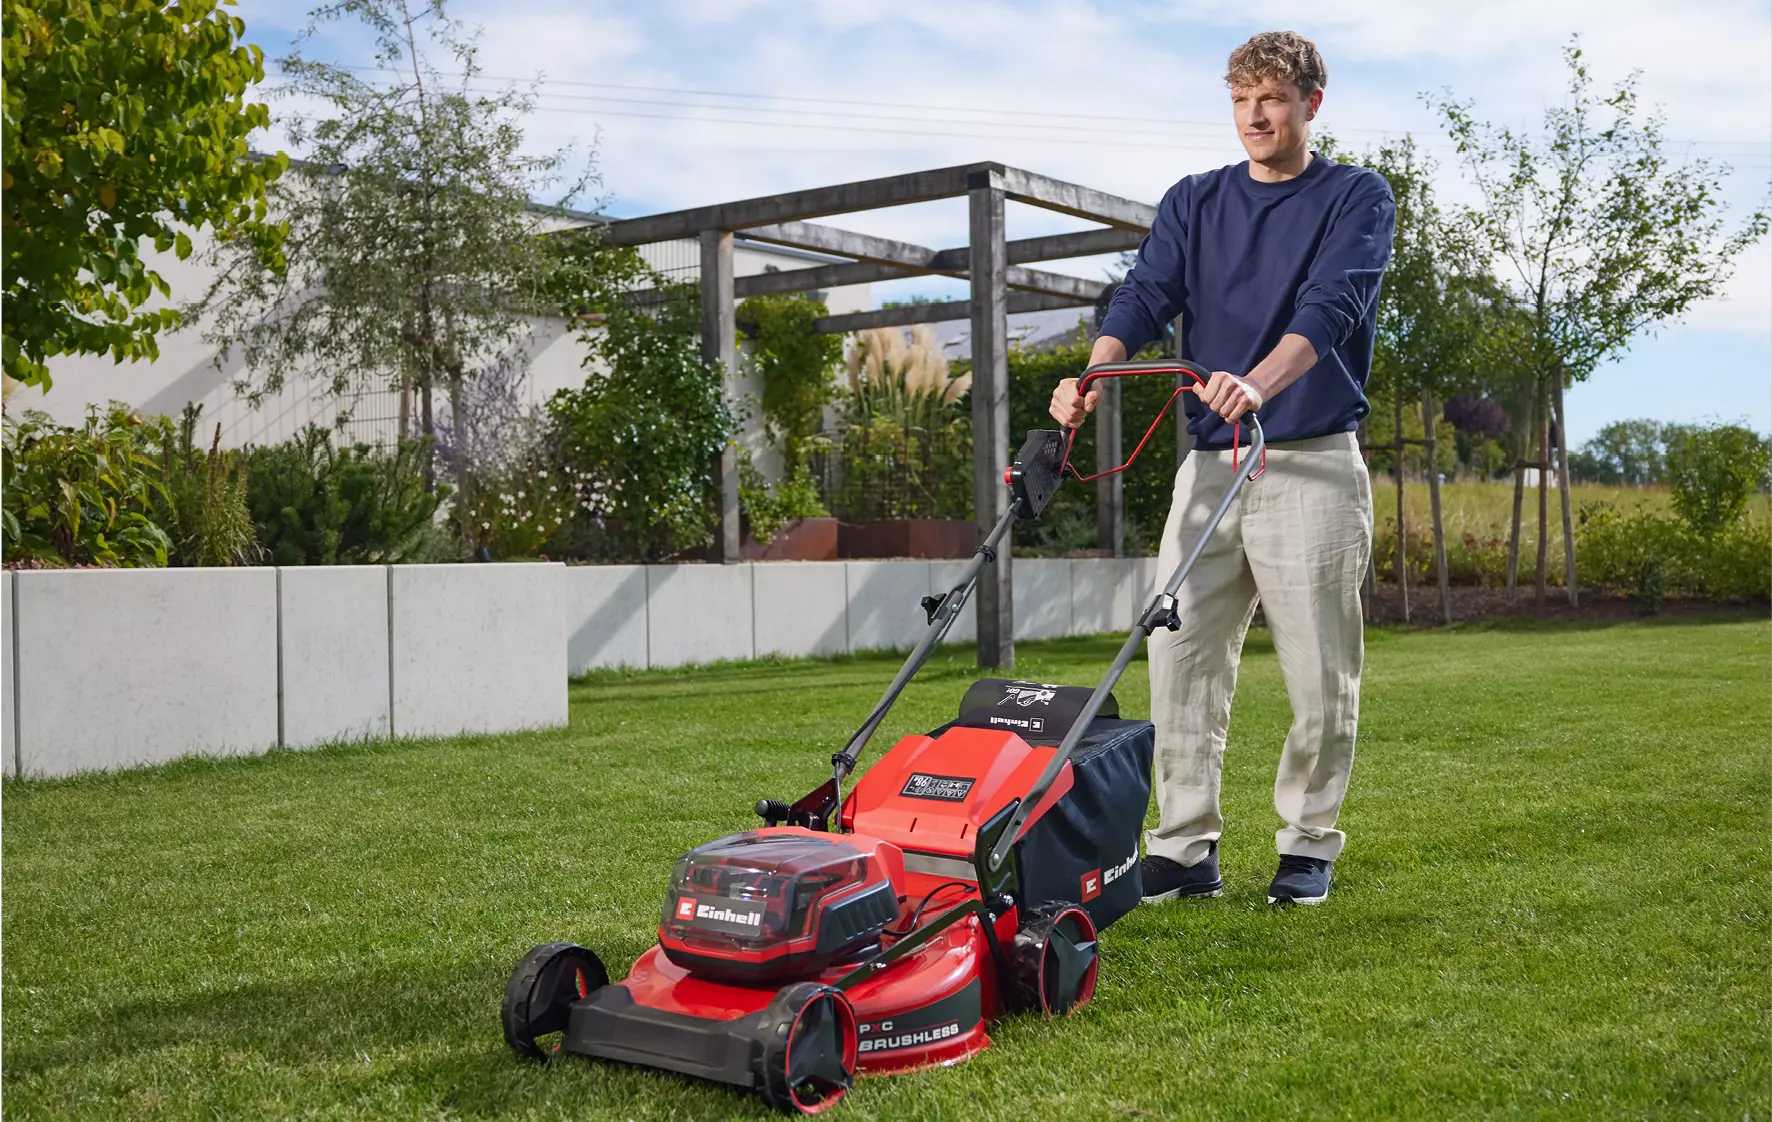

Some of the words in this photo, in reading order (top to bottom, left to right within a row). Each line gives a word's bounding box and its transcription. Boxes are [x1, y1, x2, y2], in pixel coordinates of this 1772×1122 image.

[990, 716, 1029, 728] Einhell
[696, 904, 761, 927] Einhell
[859, 1021, 894, 1034] PXC
[858, 1023, 959, 1052] BRUSHLESS
